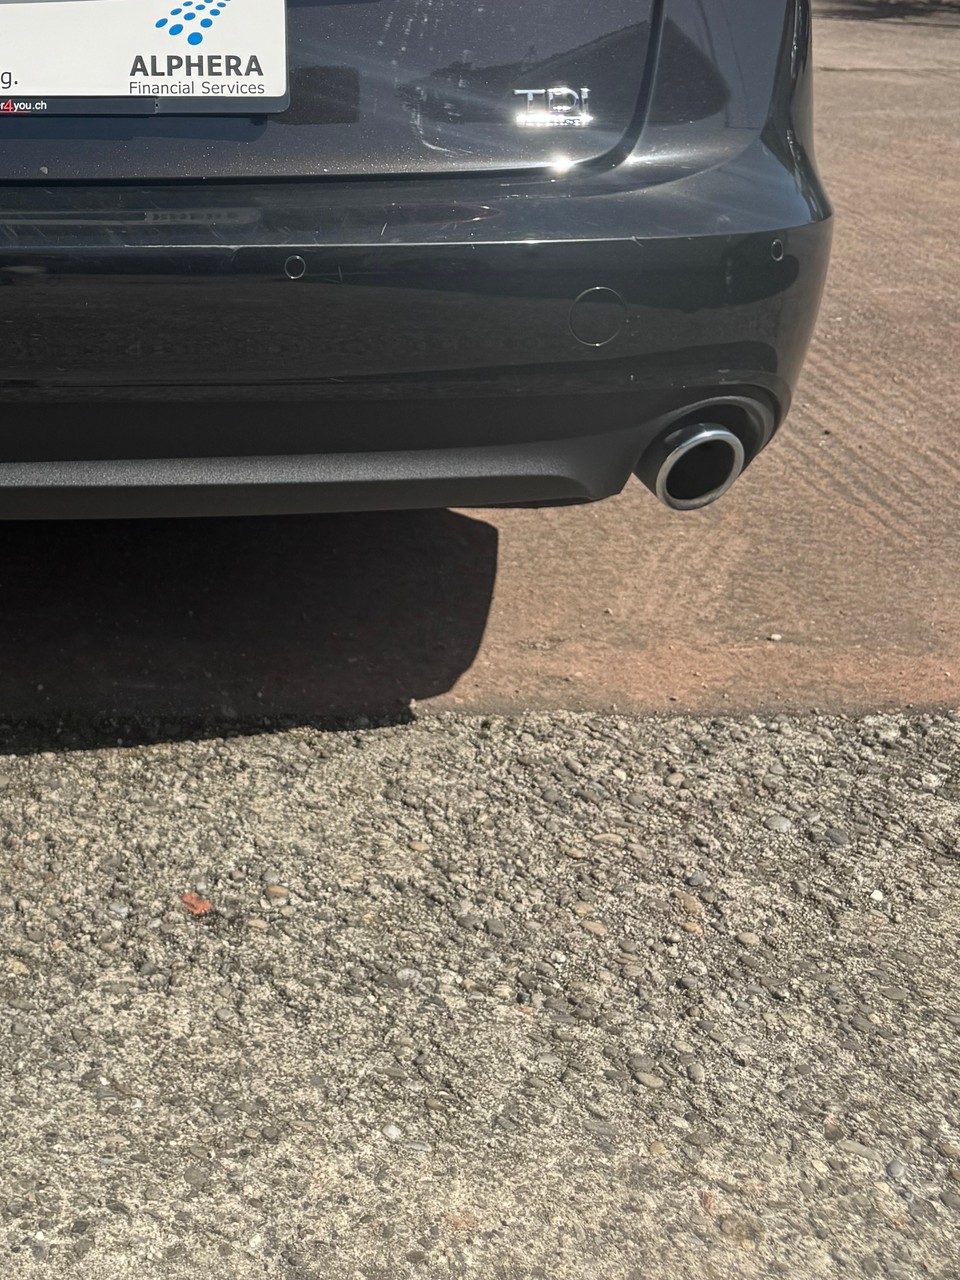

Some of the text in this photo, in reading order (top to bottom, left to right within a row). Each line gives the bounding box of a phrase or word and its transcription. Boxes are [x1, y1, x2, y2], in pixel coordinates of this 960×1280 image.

[129, 55, 265, 77] ALPHERA
[129, 81, 266, 95] Financial Services
[513, 87, 591, 114] TDI
